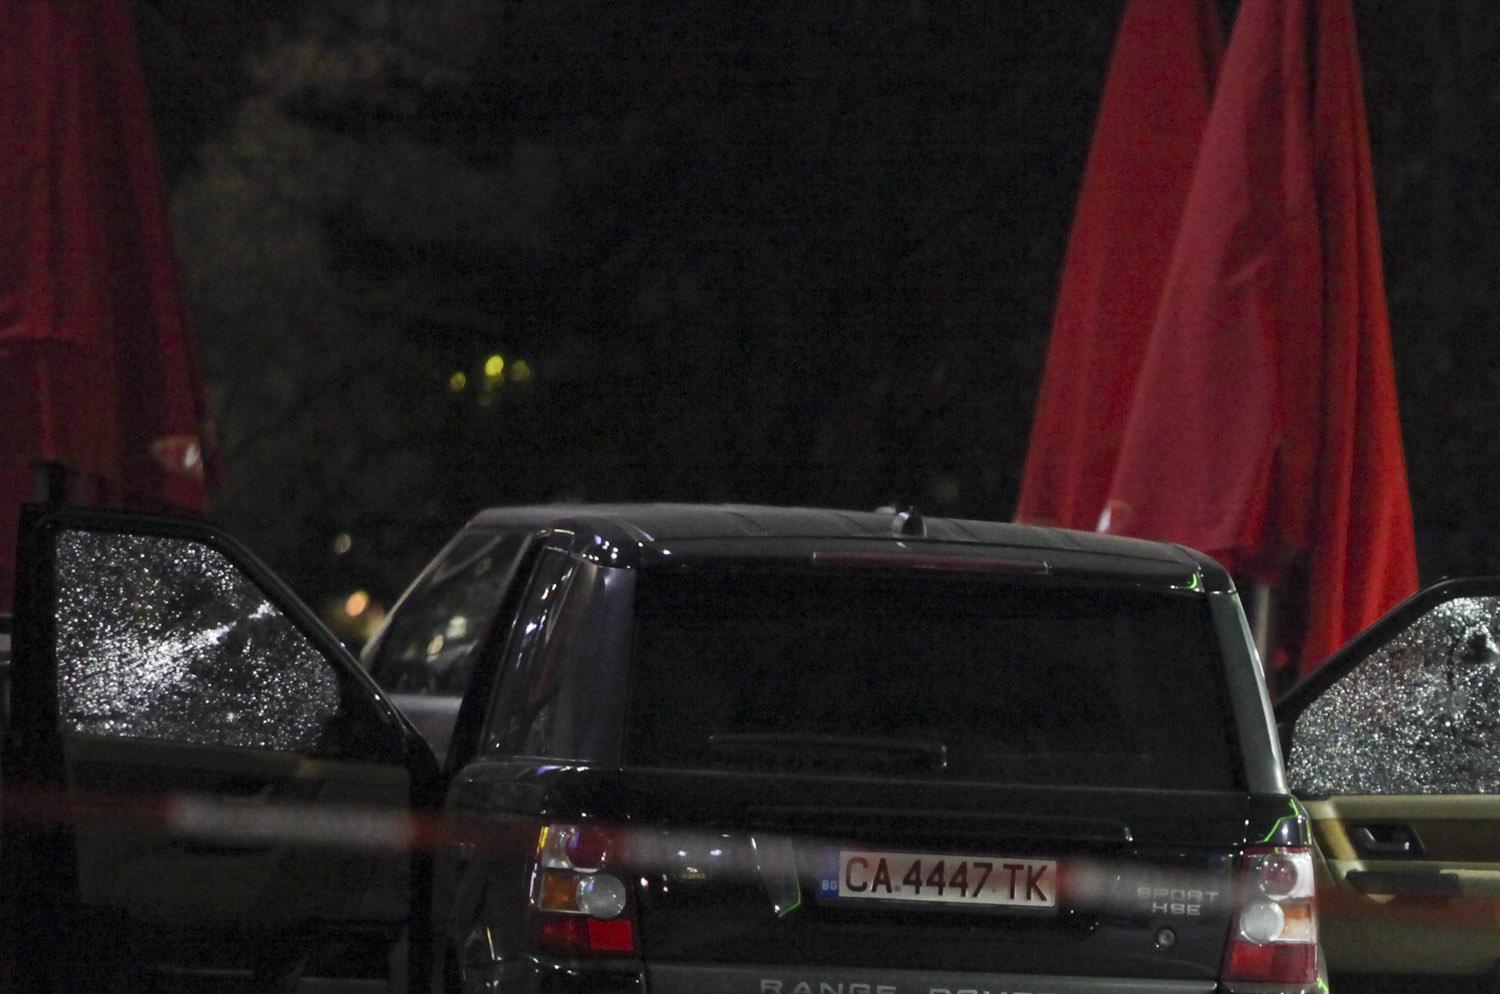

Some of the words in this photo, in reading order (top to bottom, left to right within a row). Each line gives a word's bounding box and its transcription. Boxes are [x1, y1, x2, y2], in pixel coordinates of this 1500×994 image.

[822, 879, 837, 891] BG
[845, 856, 892, 894] CA
[902, 859, 993, 898] 4447
[1002, 863, 1048, 901] TK
[1137, 886, 1219, 901] SPORT
[1152, 902, 1201, 915] HSE
